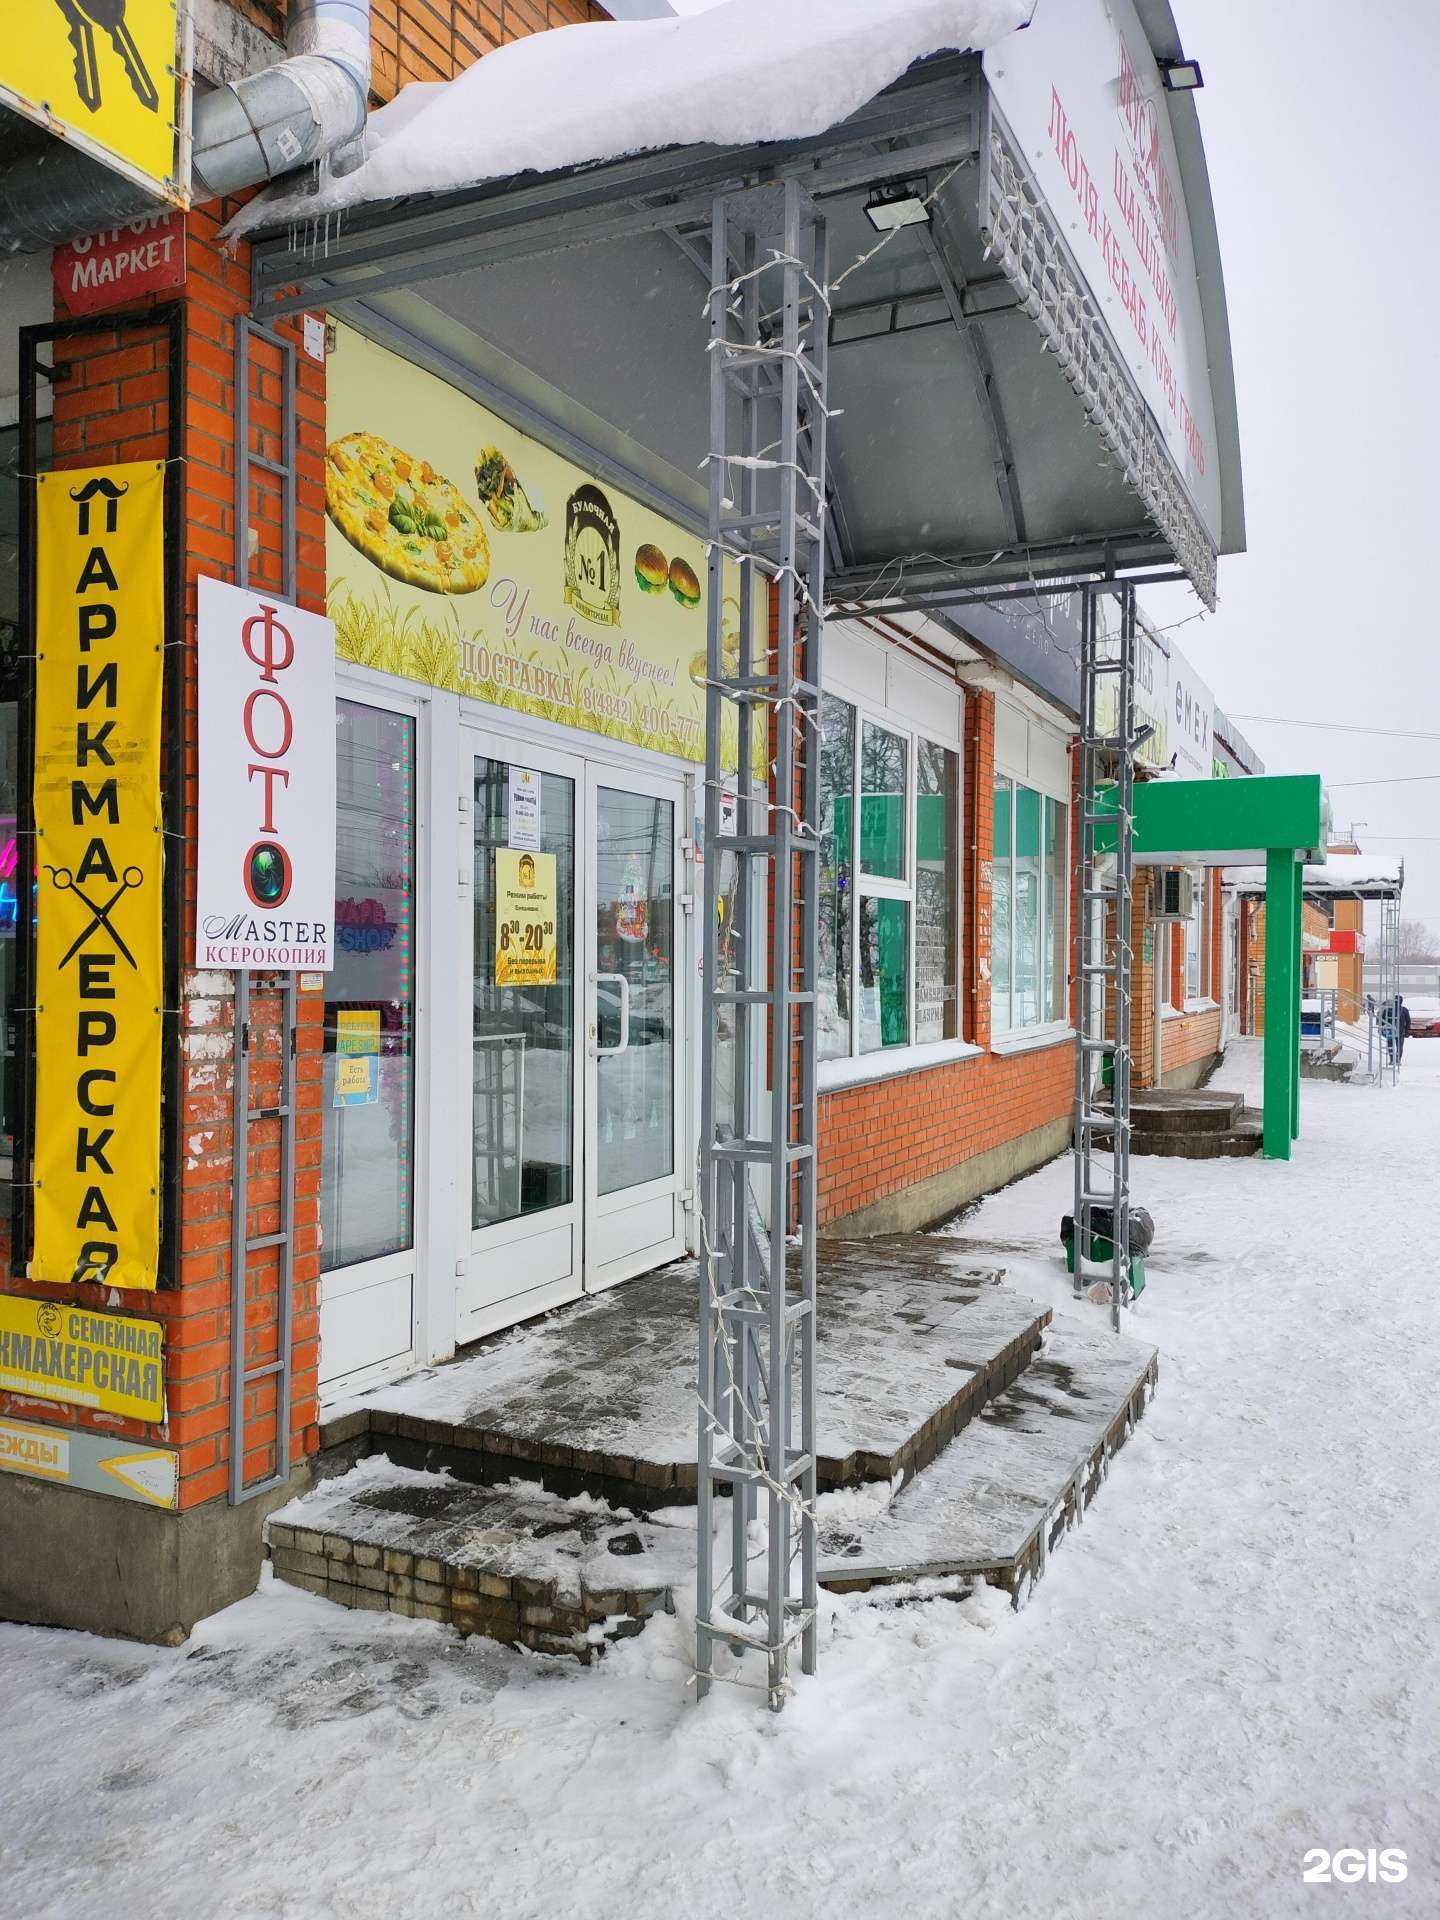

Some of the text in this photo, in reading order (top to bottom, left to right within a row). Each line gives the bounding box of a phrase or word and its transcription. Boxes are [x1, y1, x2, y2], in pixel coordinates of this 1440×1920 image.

[70, 235, 175, 293] МАРКЕТ
[1113, 144, 1177, 344] ШАШЛЫКИ
[572, 500, 615, 534] БУЛОЧНАЯ
[490, 578, 681, 688] У нас всегда вкуснее!
[458, 640, 576, 707] ДОСТАВКА
[241, 602, 295, 910] ФОТО
[205, 945, 328, 965] КСЕРОКОПИЯ
[68, 1313, 160, 1360] СЕМЕЙНАЯ
